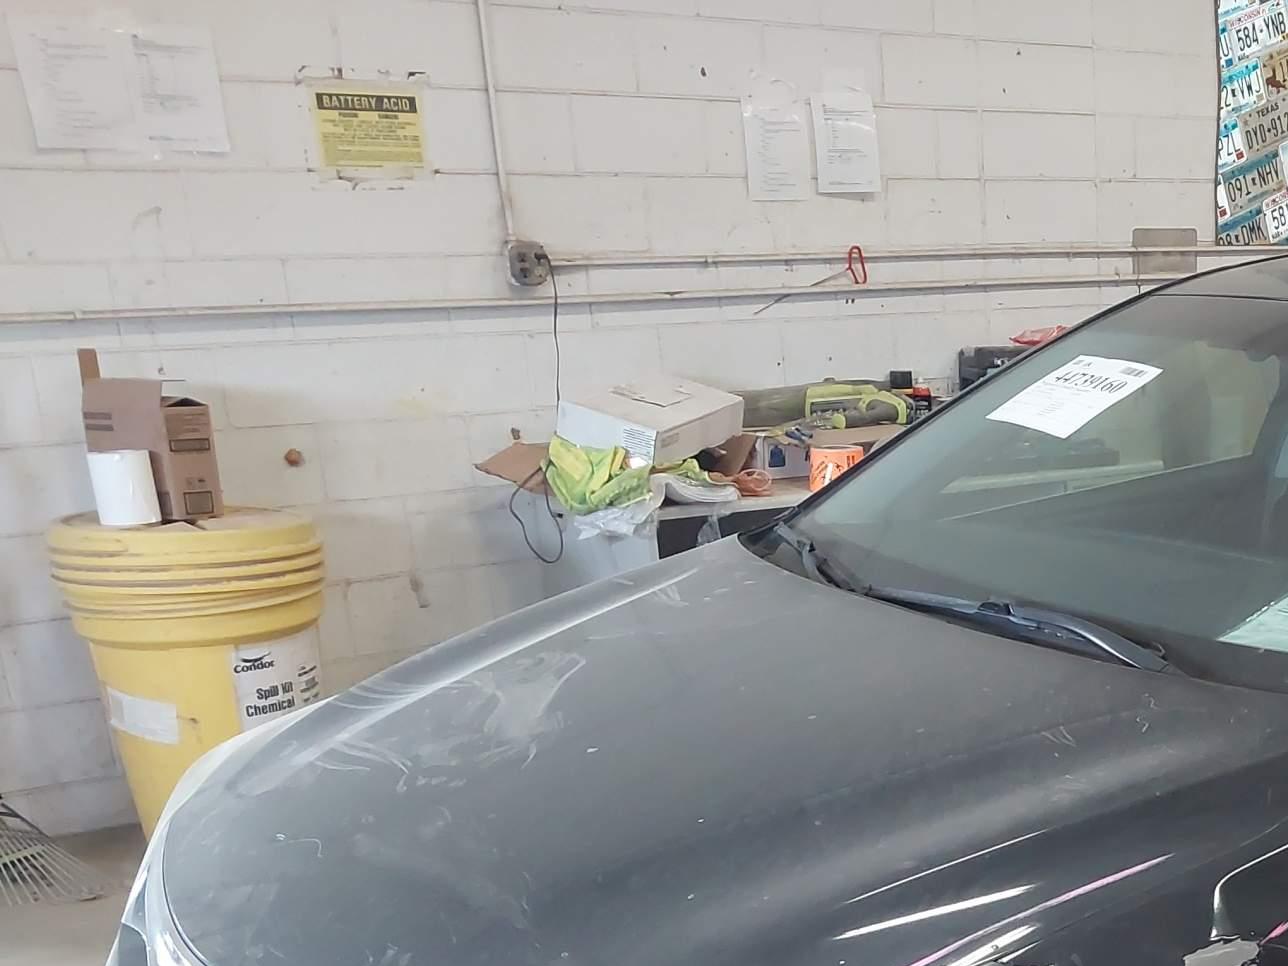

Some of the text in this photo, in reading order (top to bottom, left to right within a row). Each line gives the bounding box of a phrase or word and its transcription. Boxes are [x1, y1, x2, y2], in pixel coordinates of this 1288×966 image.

[321, 95, 410, 110] BATTERY ACID
[1256, 102, 1279, 118] TEXAS
[1055, 370, 1128, 393] 44739160
[233, 660, 275, 674] Condor
[256, 684, 280, 701] Spill
[246, 696, 295, 717] Chemical
